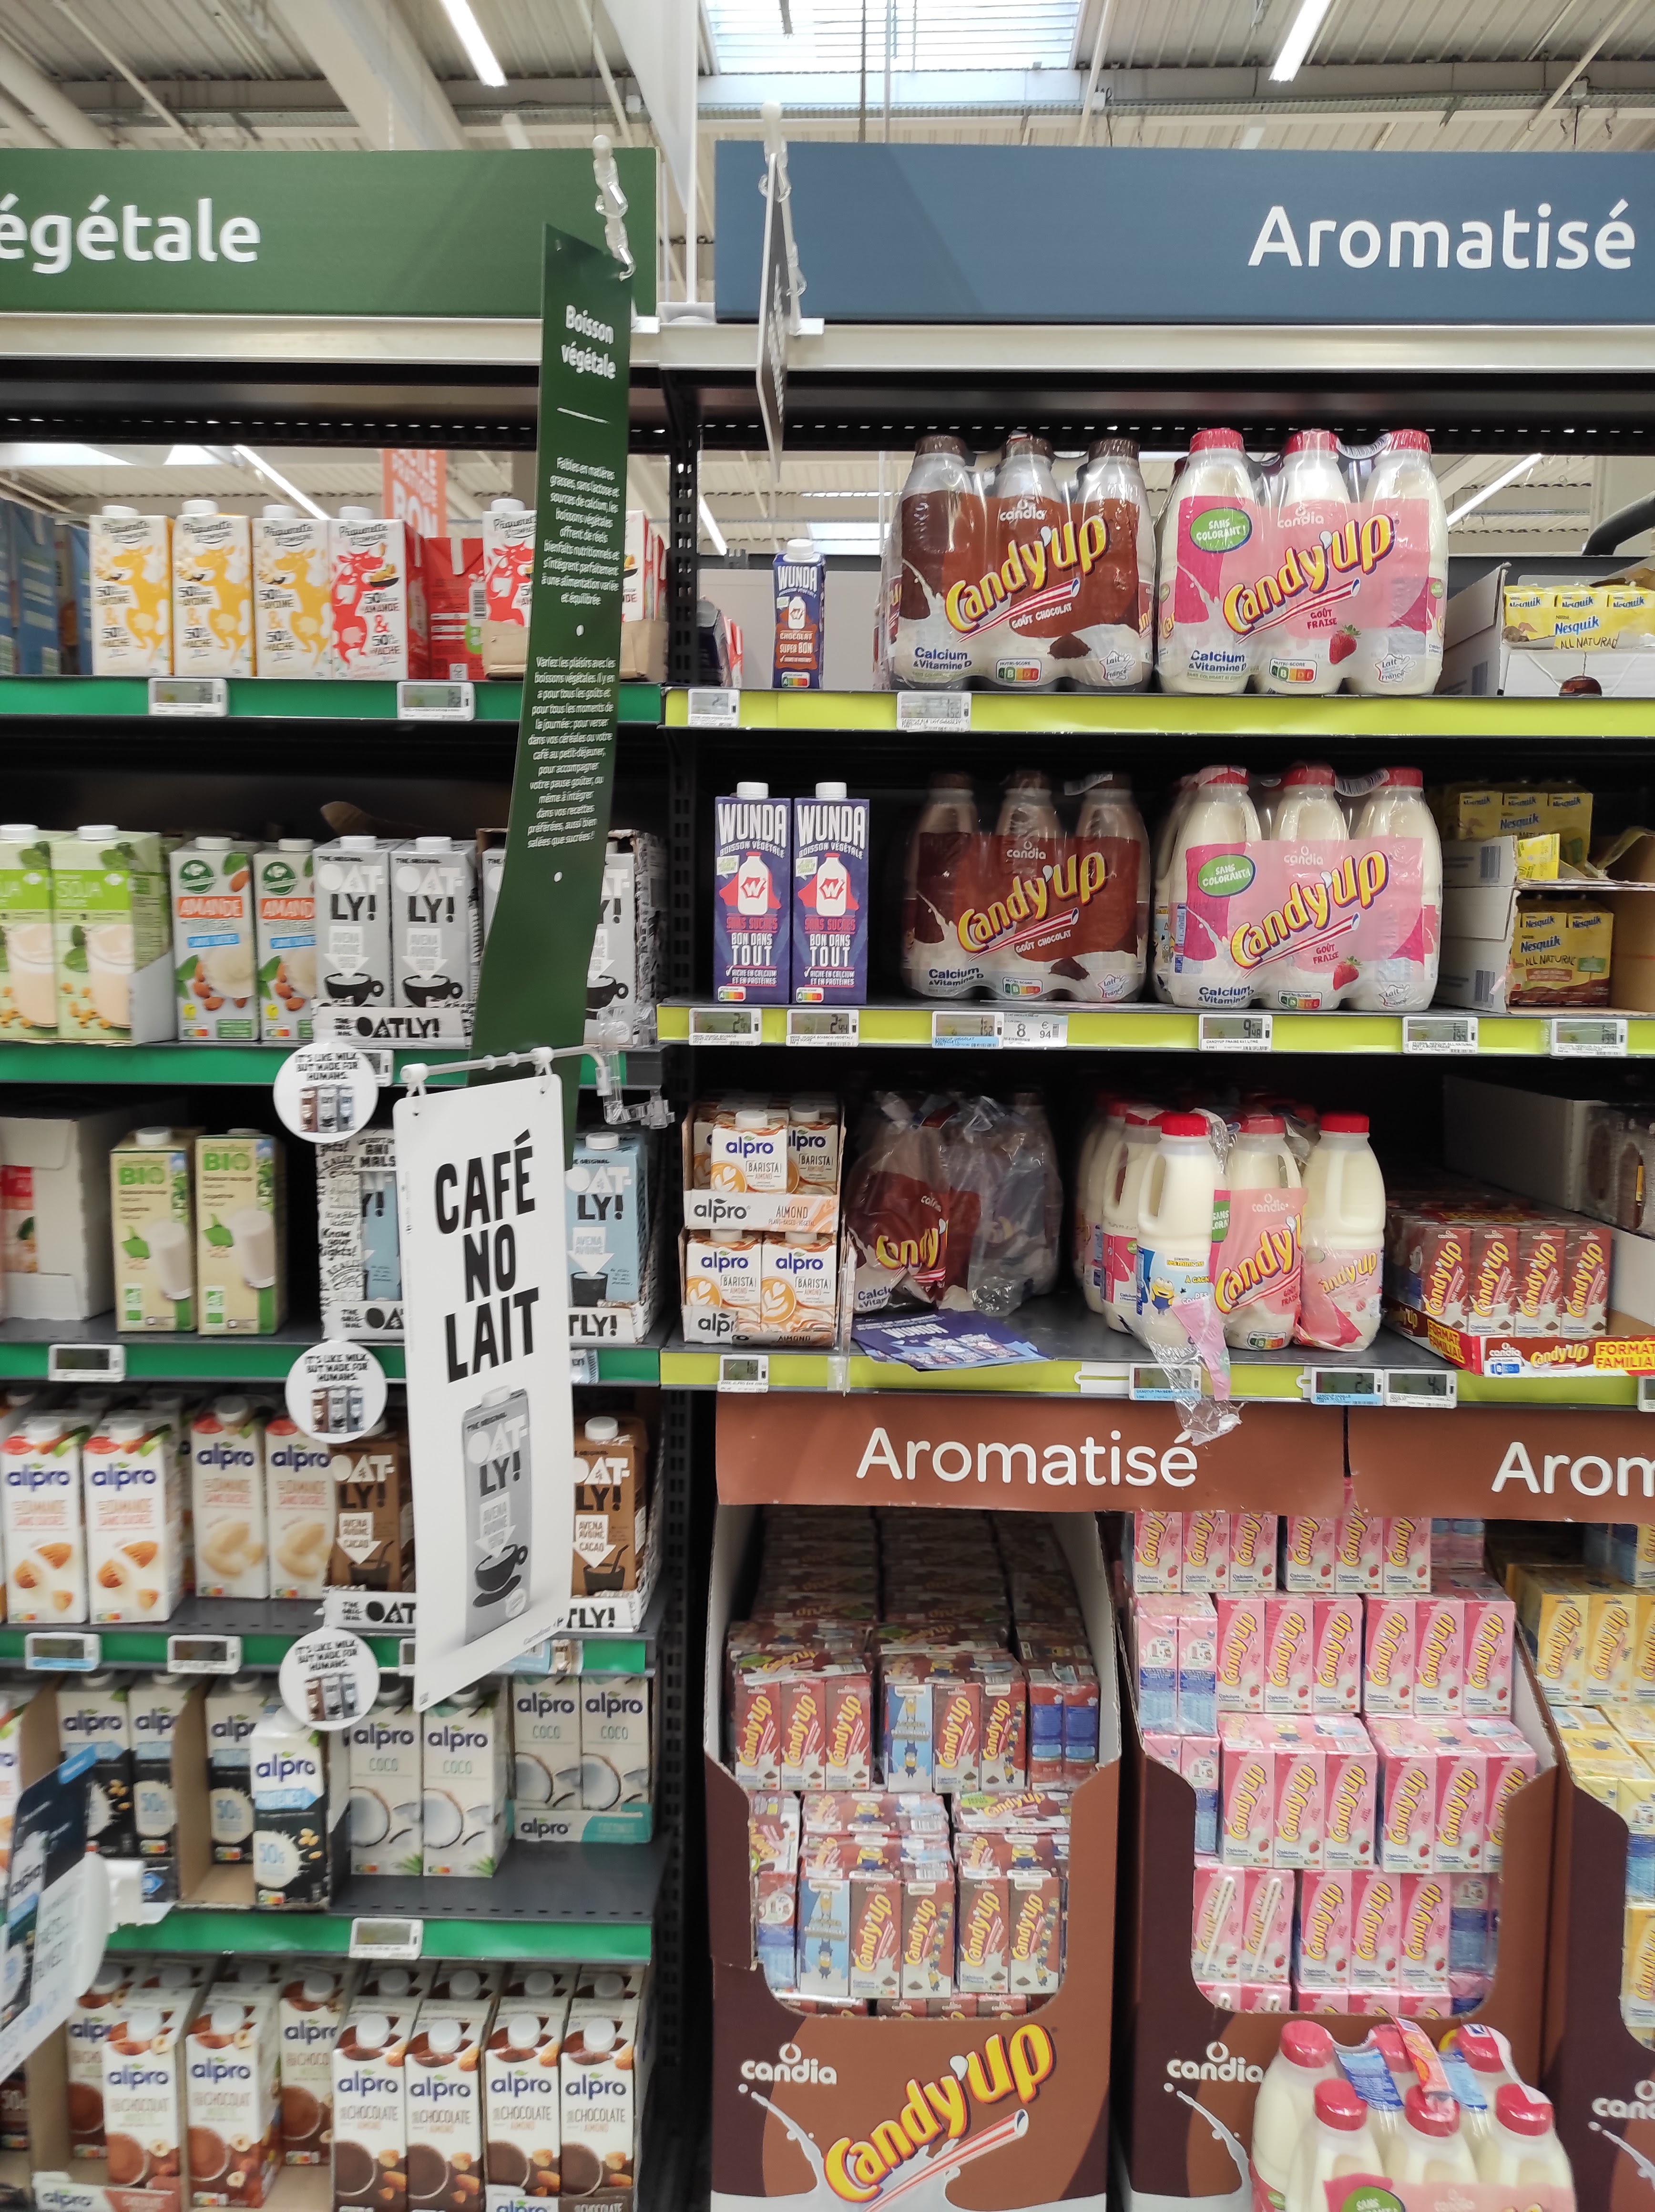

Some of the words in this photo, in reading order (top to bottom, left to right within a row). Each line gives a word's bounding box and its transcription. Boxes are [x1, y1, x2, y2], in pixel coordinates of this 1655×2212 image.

[1247, 198, 1635, 270] Aromatisé
[565, 305, 614, 345] Boisson
[561, 341, 616, 379] végétale
[1000, 508, 1046, 522] candia
[1208, 518, 1231, 530] SANS
[1277, 512, 1324, 529] candia
[1196, 526, 1240, 543] COLORANT
[777, 566, 817, 591] WUNDA
[1011, 614, 1032, 629] GOÛT
[1036, 603, 1073, 621] CHOCOLAT
[1310, 607, 1332, 619] GOÛT
[1307, 617, 1338, 630] FRAISE
[1554, 616, 1599, 635] Nesquik
[779, 645, 797, 654] SUPER
[798, 642, 813, 654] BON
[1560, 638, 1574, 650] ALL
[914, 647, 968, 661] Calcium
[1191, 649, 1245, 664] Calcium
[1382, 658, 1397, 668] Lait
[531, 706, 550, 717] pour
[718, 803, 789, 848] WUNDA
[797, 804, 868, 849] WUNDA
[1500, 813, 1540, 830] Nesquik
[720, 842, 751, 857] BOISSON
[1006, 848, 1046, 860] candia
[1216, 862, 1236, 873] SANS
[1283, 853, 1324, 866] candia
[329, 894, 376, 921] LY!
[408, 896, 455, 923] LY!
[1573, 916, 1601, 928] Nesquik
[731, 933, 749, 946] BON
[751, 933, 772, 946] DANS
[810, 934, 828, 947] BON
[829, 934, 851, 948] DANS
[1015, 942, 1035, 953] GOÛT
[1037, 929, 1072, 947] CHOCOLAT
[1520, 935, 1561, 953] Nesquik
[732, 945, 773, 966] TOUT
[810, 946, 851, 968] TOUT
[1313, 952, 1339, 964] FRAISE
[1316, 943, 1336, 956] GOÛT
[1525, 957, 1538, 966] ALL
[754, 969, 776, 977] CALCIUM
[929, 966, 980, 980] Calcium
[1199, 985, 1251, 998] Calcium
[1016, 1023, 1026, 1038] 8
[1040, 1029, 1052, 1039] 94
[1042, 1021, 1049, 1030] €
[1243, 1019, 1252, 1038] 9
[725, 1136, 774, 1158] alpro
[748, 1162, 781, 1173] BARISTA
[434, 1129, 536, 1235] CAFÉ
[577, 1194, 623, 1220] LY!
[694, 1198, 747, 1222] alpro
[776, 1206, 808, 1219] ALMOND
[1251, 1201, 1287, 1212] candia
[463, 1224, 516, 1303] NO
[701, 1252, 749, 1272] alpro
[776, 1252, 824, 1273] alpro
[723, 1277, 755, 1287] BARISTA
[798, 1278, 830, 1289] BARISTA
[444, 1286, 540, 1383] LAIT
[1428, 1320, 1459, 1342] FORMAT
[1429, 1334, 1466, 1363] FAMILIAL
[271, 1448, 331, 1472] alpro
[856, 1427, 1198, 1489] Aromatisé
[92, 1464, 156, 1491] alpro
[480, 1451, 521, 1497] LY!
[575, 1485, 621, 1511] LY!
[517, 1693, 575, 1718] alpro
[585, 1692, 644, 1718] alpro
[353, 1723, 415, 1750] alpro
[427, 1727, 488, 1752] alpro
[532, 1725, 560, 1739] COCO
[521, 1819, 568, 1838] alpro
[740, 2057, 838, 2086] candia
[1165, 2049, 1264, 2083] candia
[107, 2066, 170, 2089] alpro
[337, 2071, 398, 2097] alpro
[491, 2071, 552, 2097] alpro
[565, 2074, 626, 2100] alpro
[409, 2076, 471, 2101] alpro
[347, 2106, 398, 2121] CHOCOLATE
[574, 2109, 626, 2123] CHOCOLATE
